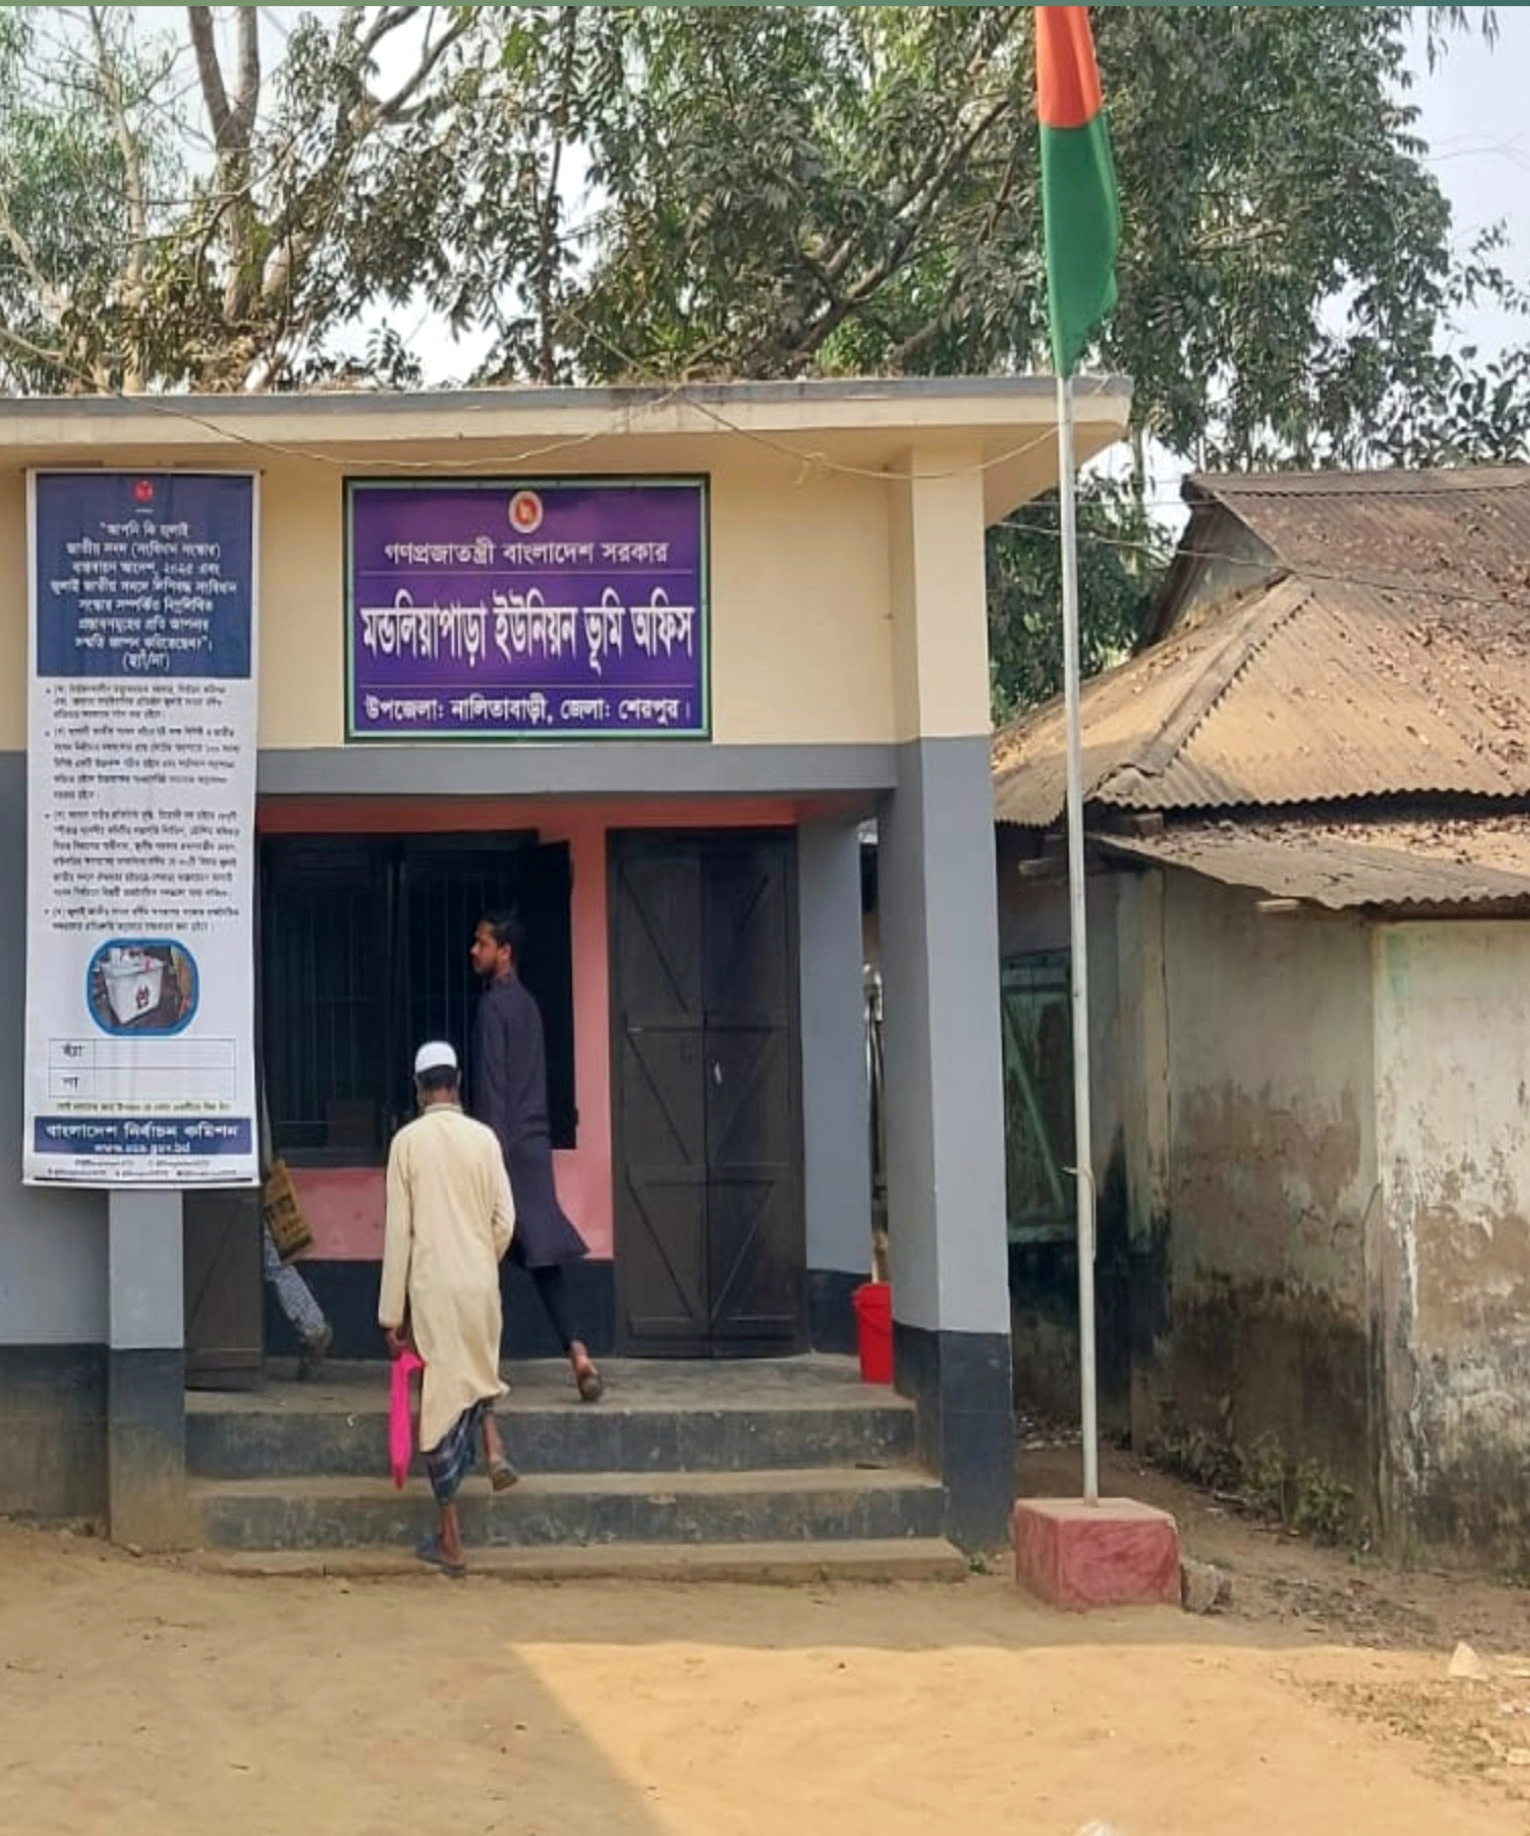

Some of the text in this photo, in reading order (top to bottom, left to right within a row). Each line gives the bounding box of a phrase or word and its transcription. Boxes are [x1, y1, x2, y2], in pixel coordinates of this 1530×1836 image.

[384, 536, 670, 565] গণপ্রজাতন্ত্রী বাংলাদেশ সরকার
[359, 587, 695, 677] মন্ডলিয়াপাড়া ইউনিয়ন ভূমি অফিস
[46, 1120, 239, 1139] বাংলাদেশ নির্বাচন কমিশন
